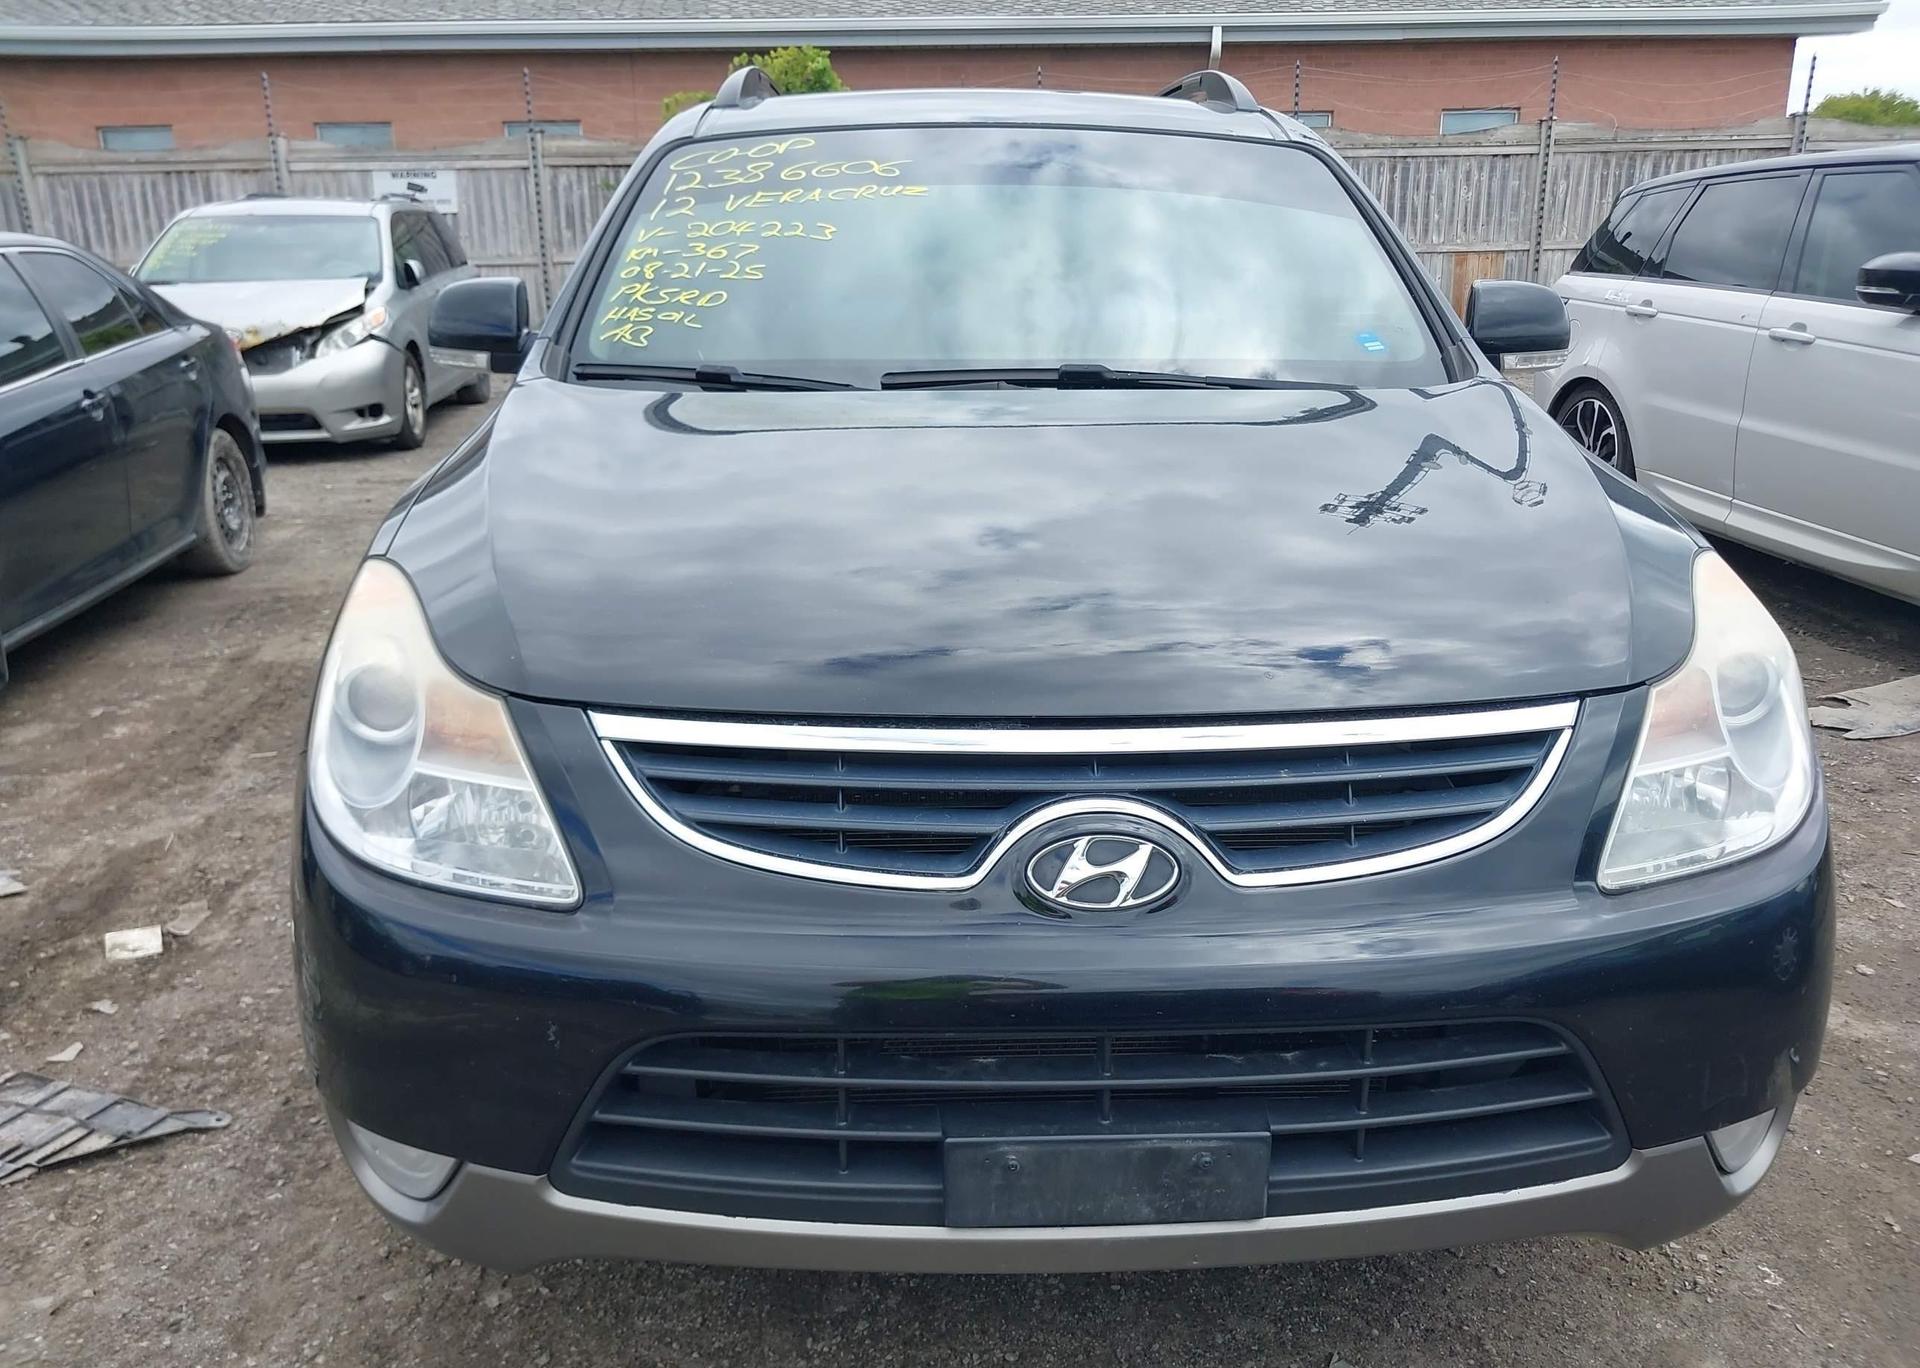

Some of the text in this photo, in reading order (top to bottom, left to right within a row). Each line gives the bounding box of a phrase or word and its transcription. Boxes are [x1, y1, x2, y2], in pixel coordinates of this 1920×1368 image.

[650, 184, 929, 221] 12 VERACRUZ
[620, 260, 766, 280] 08-21-25
